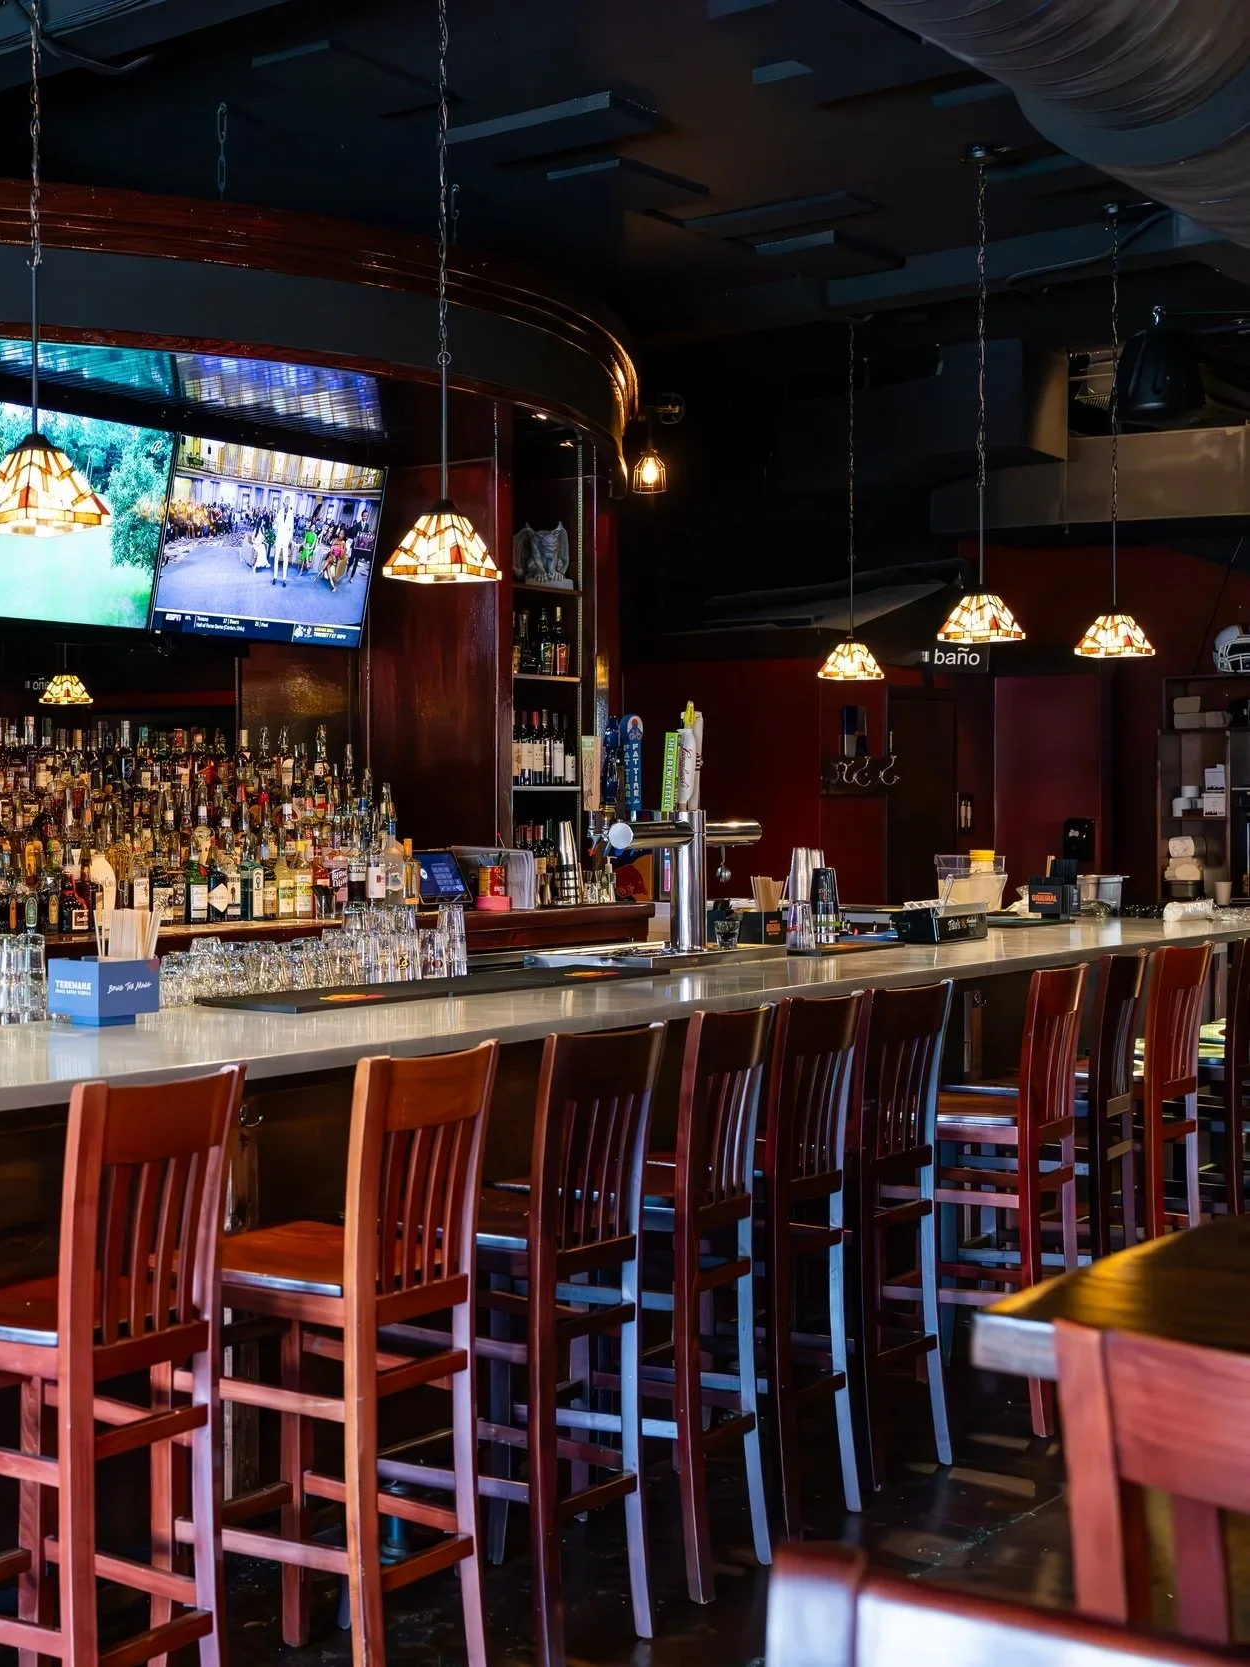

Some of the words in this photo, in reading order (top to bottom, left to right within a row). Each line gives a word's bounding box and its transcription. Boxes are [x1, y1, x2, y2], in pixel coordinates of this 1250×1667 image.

[165, 613, 182, 621] ESPN
[934, 647, 980, 665] baño
[667, 737, 675, 752] THE
[664, 779, 672, 808] KETTLE
[55, 980, 92, 991] TEREMANA
